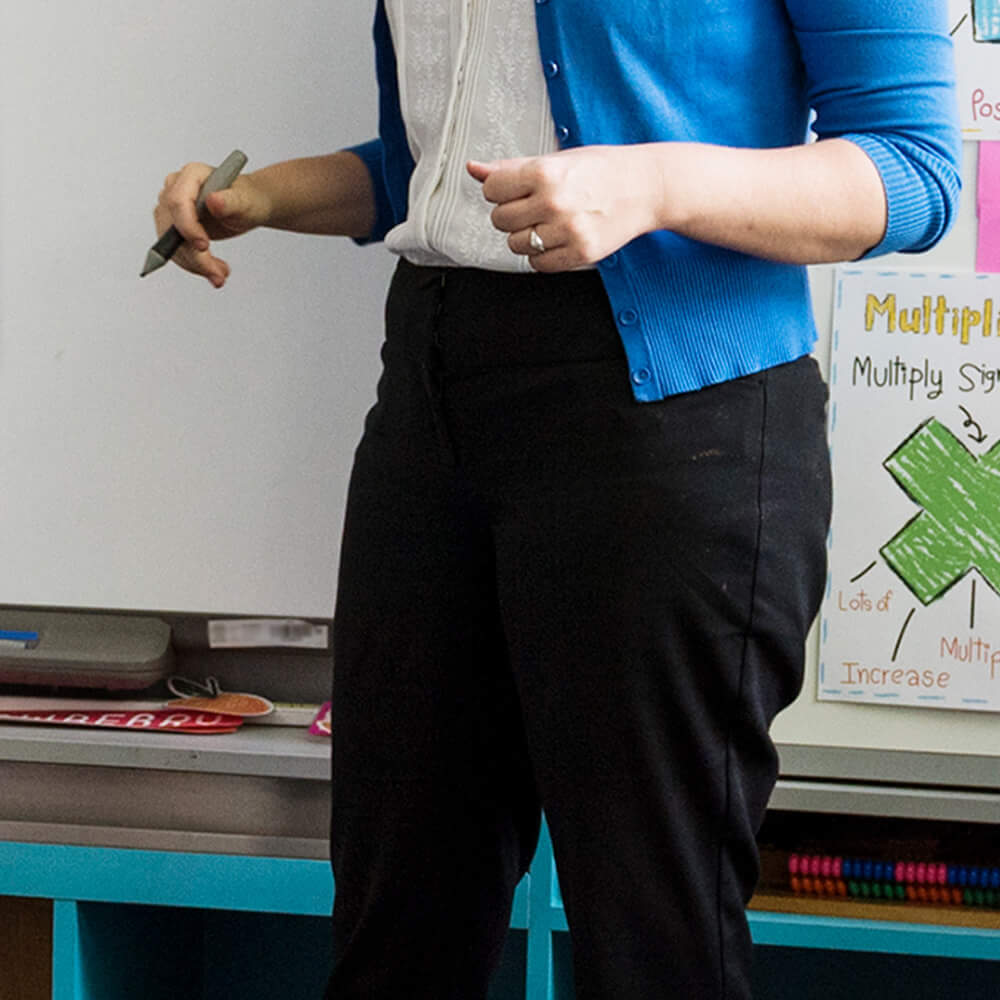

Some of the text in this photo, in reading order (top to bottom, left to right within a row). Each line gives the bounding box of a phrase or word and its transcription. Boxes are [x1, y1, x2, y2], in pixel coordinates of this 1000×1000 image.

[852, 355, 943, 401] Multiply
[838, 589, 893, 612] Lots of
[840, 662, 950, 688] Increase
